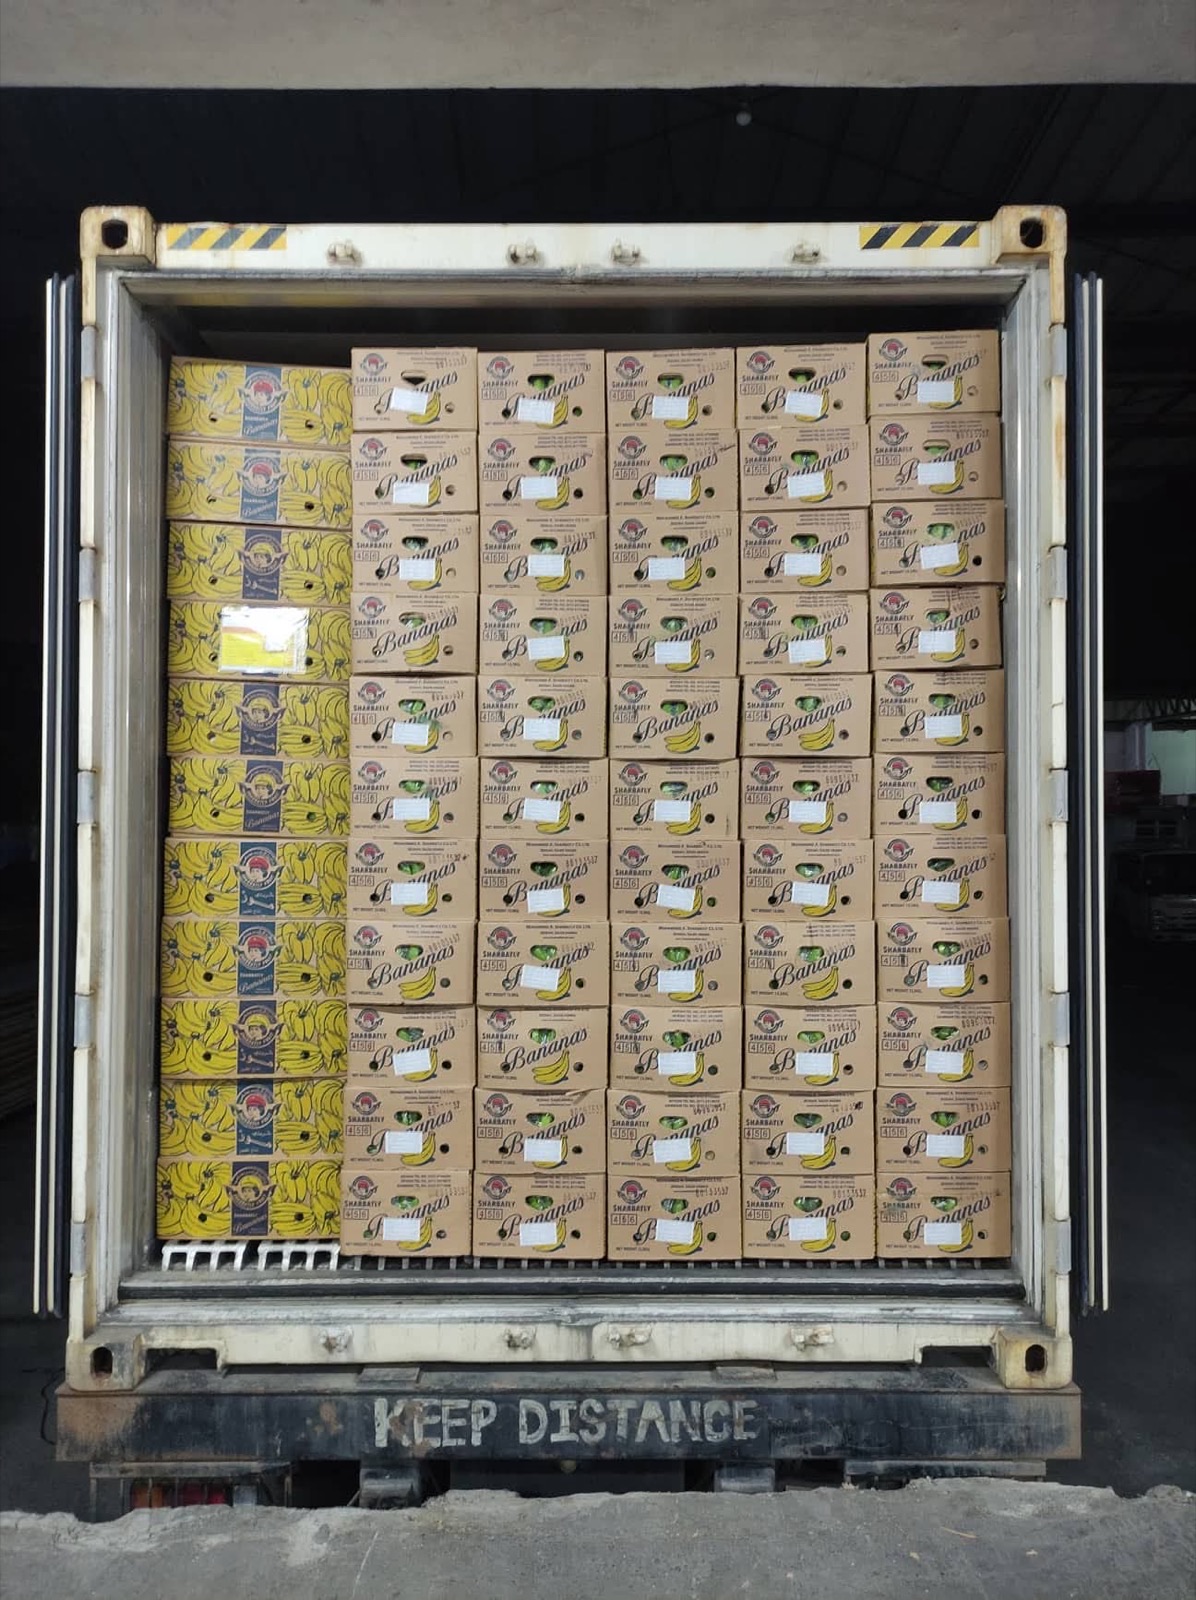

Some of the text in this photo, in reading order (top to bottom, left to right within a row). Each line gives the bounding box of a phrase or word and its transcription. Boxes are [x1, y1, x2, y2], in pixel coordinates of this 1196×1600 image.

[375, 614, 455, 656] Bananas
[898, 610, 981, 653] Bnas
[504, 698, 585, 740] Bnas
[636, 699, 716, 741] Bananas
[769, 697, 852, 740] Bananas
[375, 779, 455, 821] Bnas
[636, 782, 716, 824] Bnas
[373, 862, 454, 904] Bnas
[371, 945, 452, 987] Bananas
[773, 944, 857, 989] Bananas
[504, 1028, 587, 1071] Bananas
[769, 1114, 853, 1158] Bnas
[374, 1398, 757, 1448] KEEP DISTANCE
